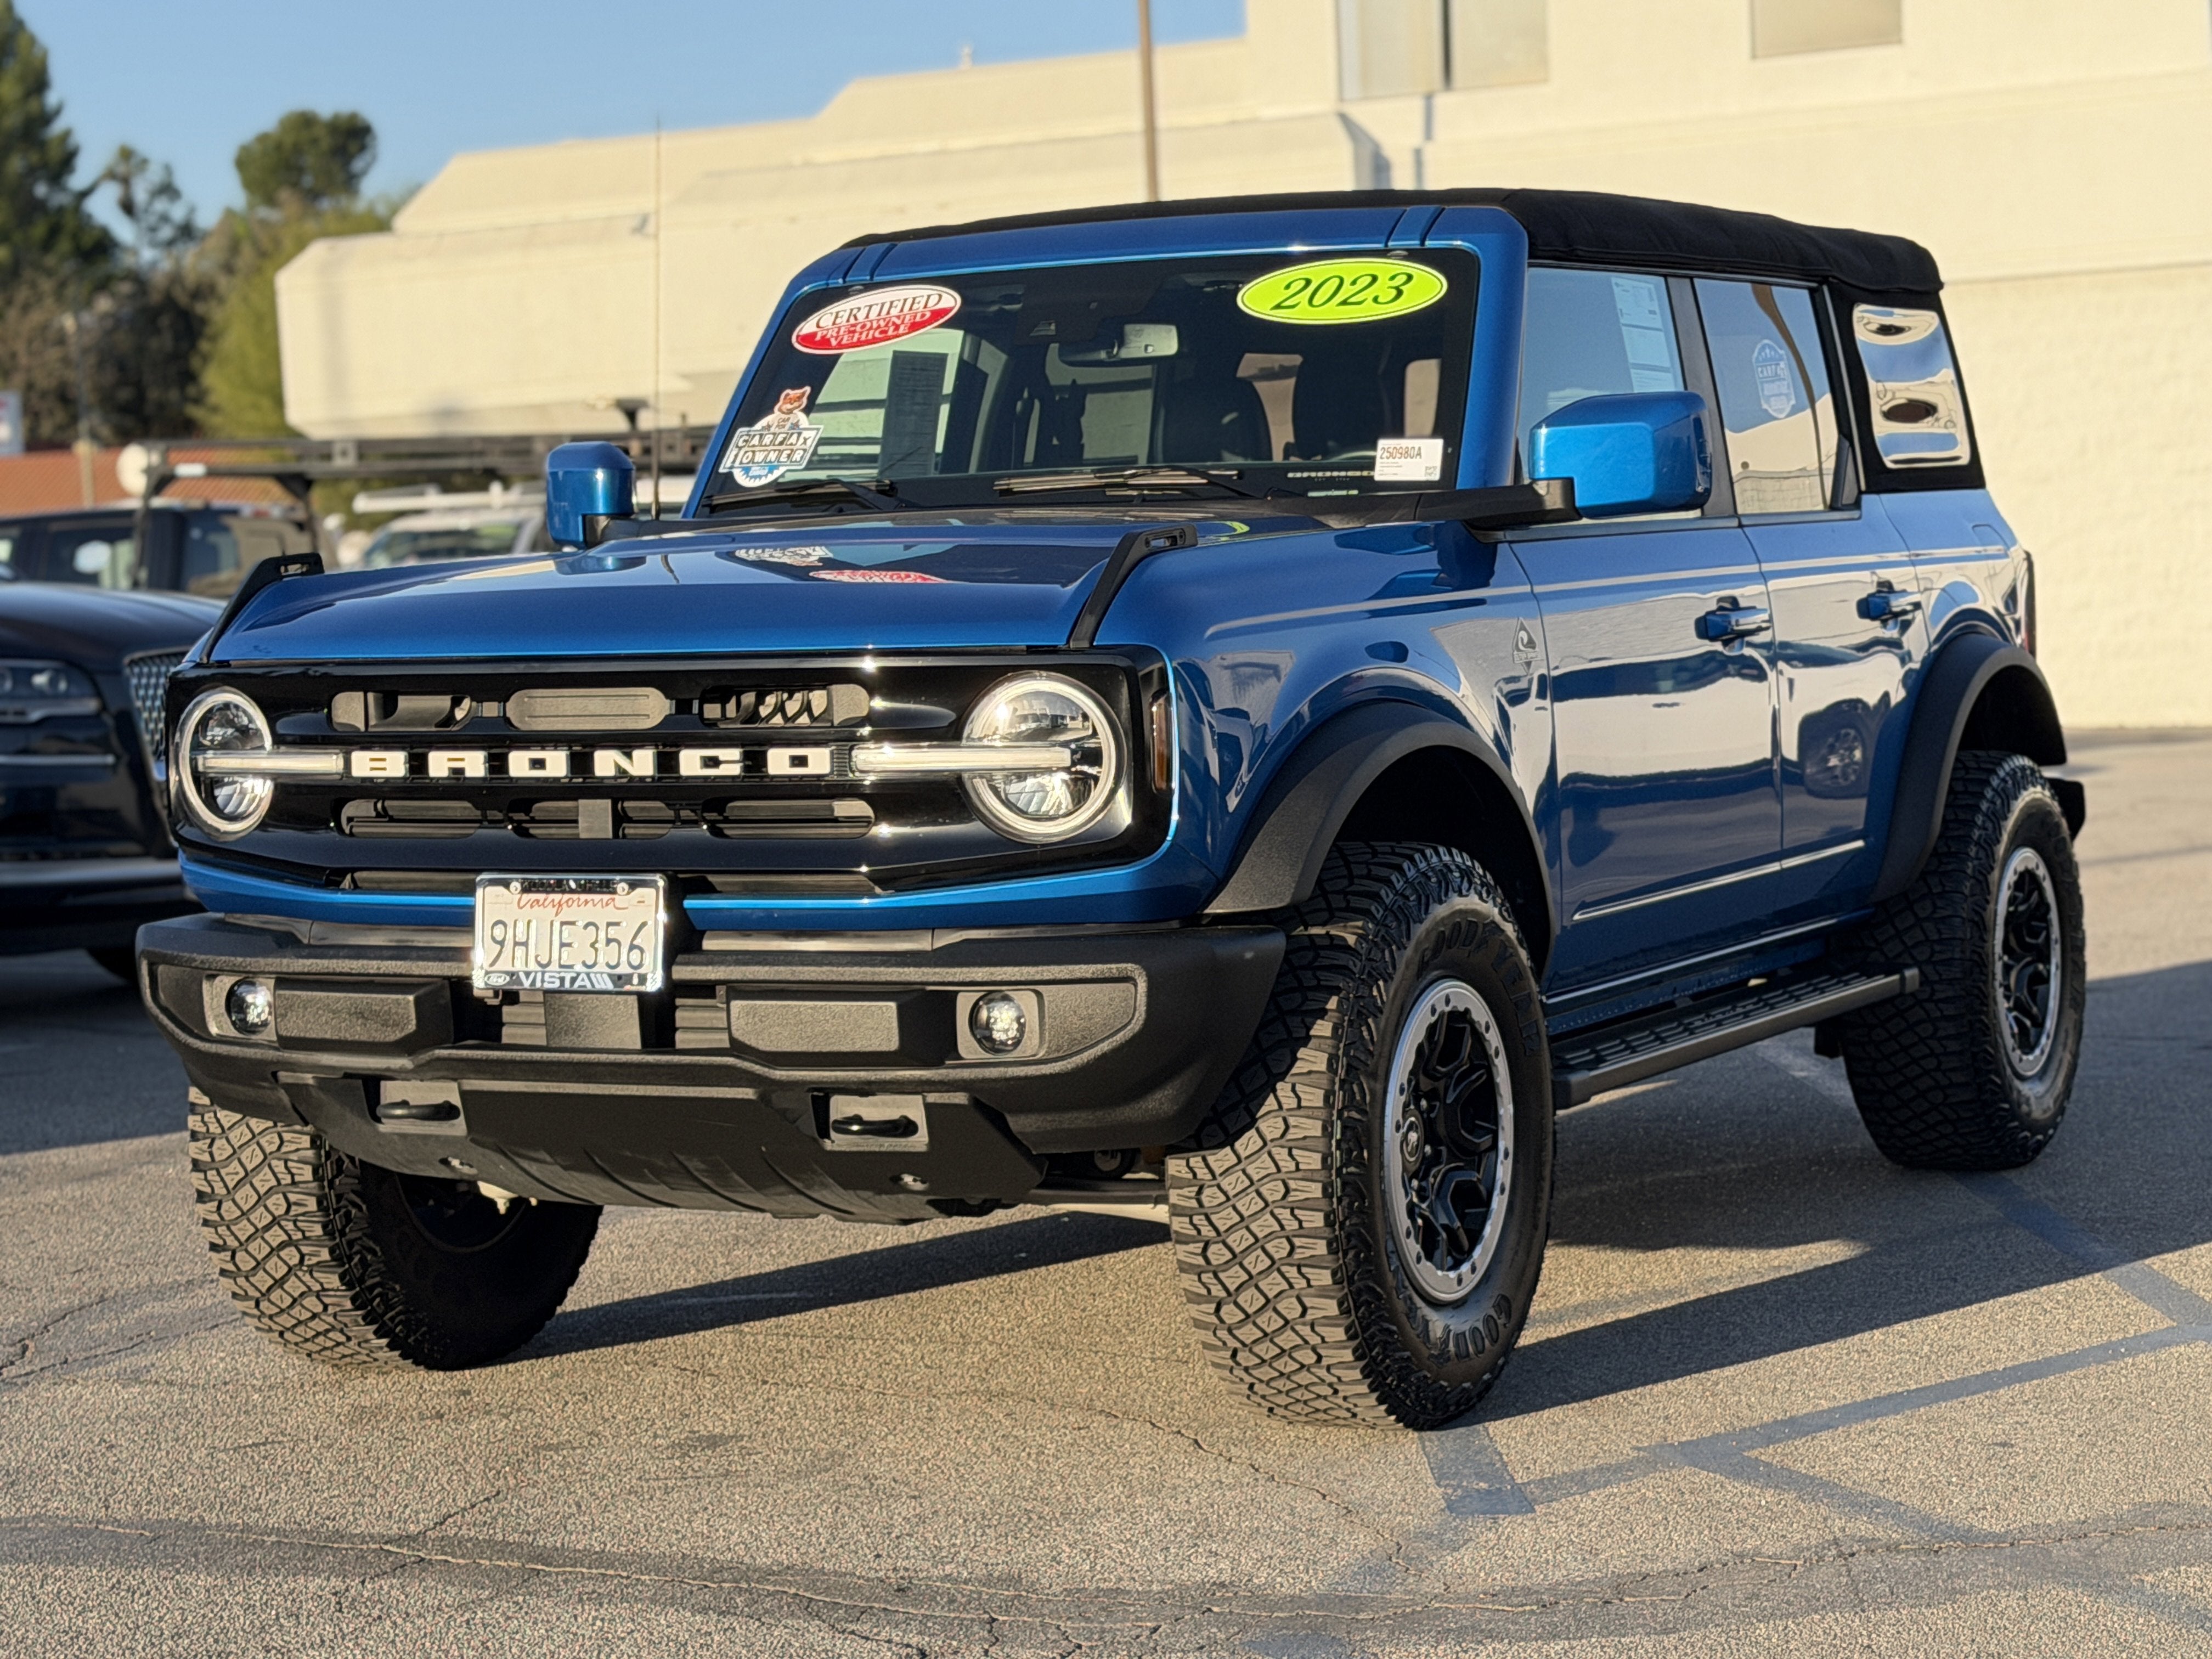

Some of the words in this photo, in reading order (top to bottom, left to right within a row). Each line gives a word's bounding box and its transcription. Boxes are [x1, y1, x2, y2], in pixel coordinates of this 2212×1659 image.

[1269, 272, 1414, 311] 2023
[816, 293, 943, 329] CERTIFIED
[815, 311, 932, 342] PRE-OWNED
[830, 323, 910, 347] VEHICLE
[737, 432, 812, 448] CARFAX
[741, 449, 805, 464] OWNER
[1379, 446, 1422, 460] 250980A
[351, 748, 832, 778] BRONCO
[517, 893, 629, 917] California
[489, 919, 650, 970] 9HJE356
[518, 972, 590, 989] VISTA
